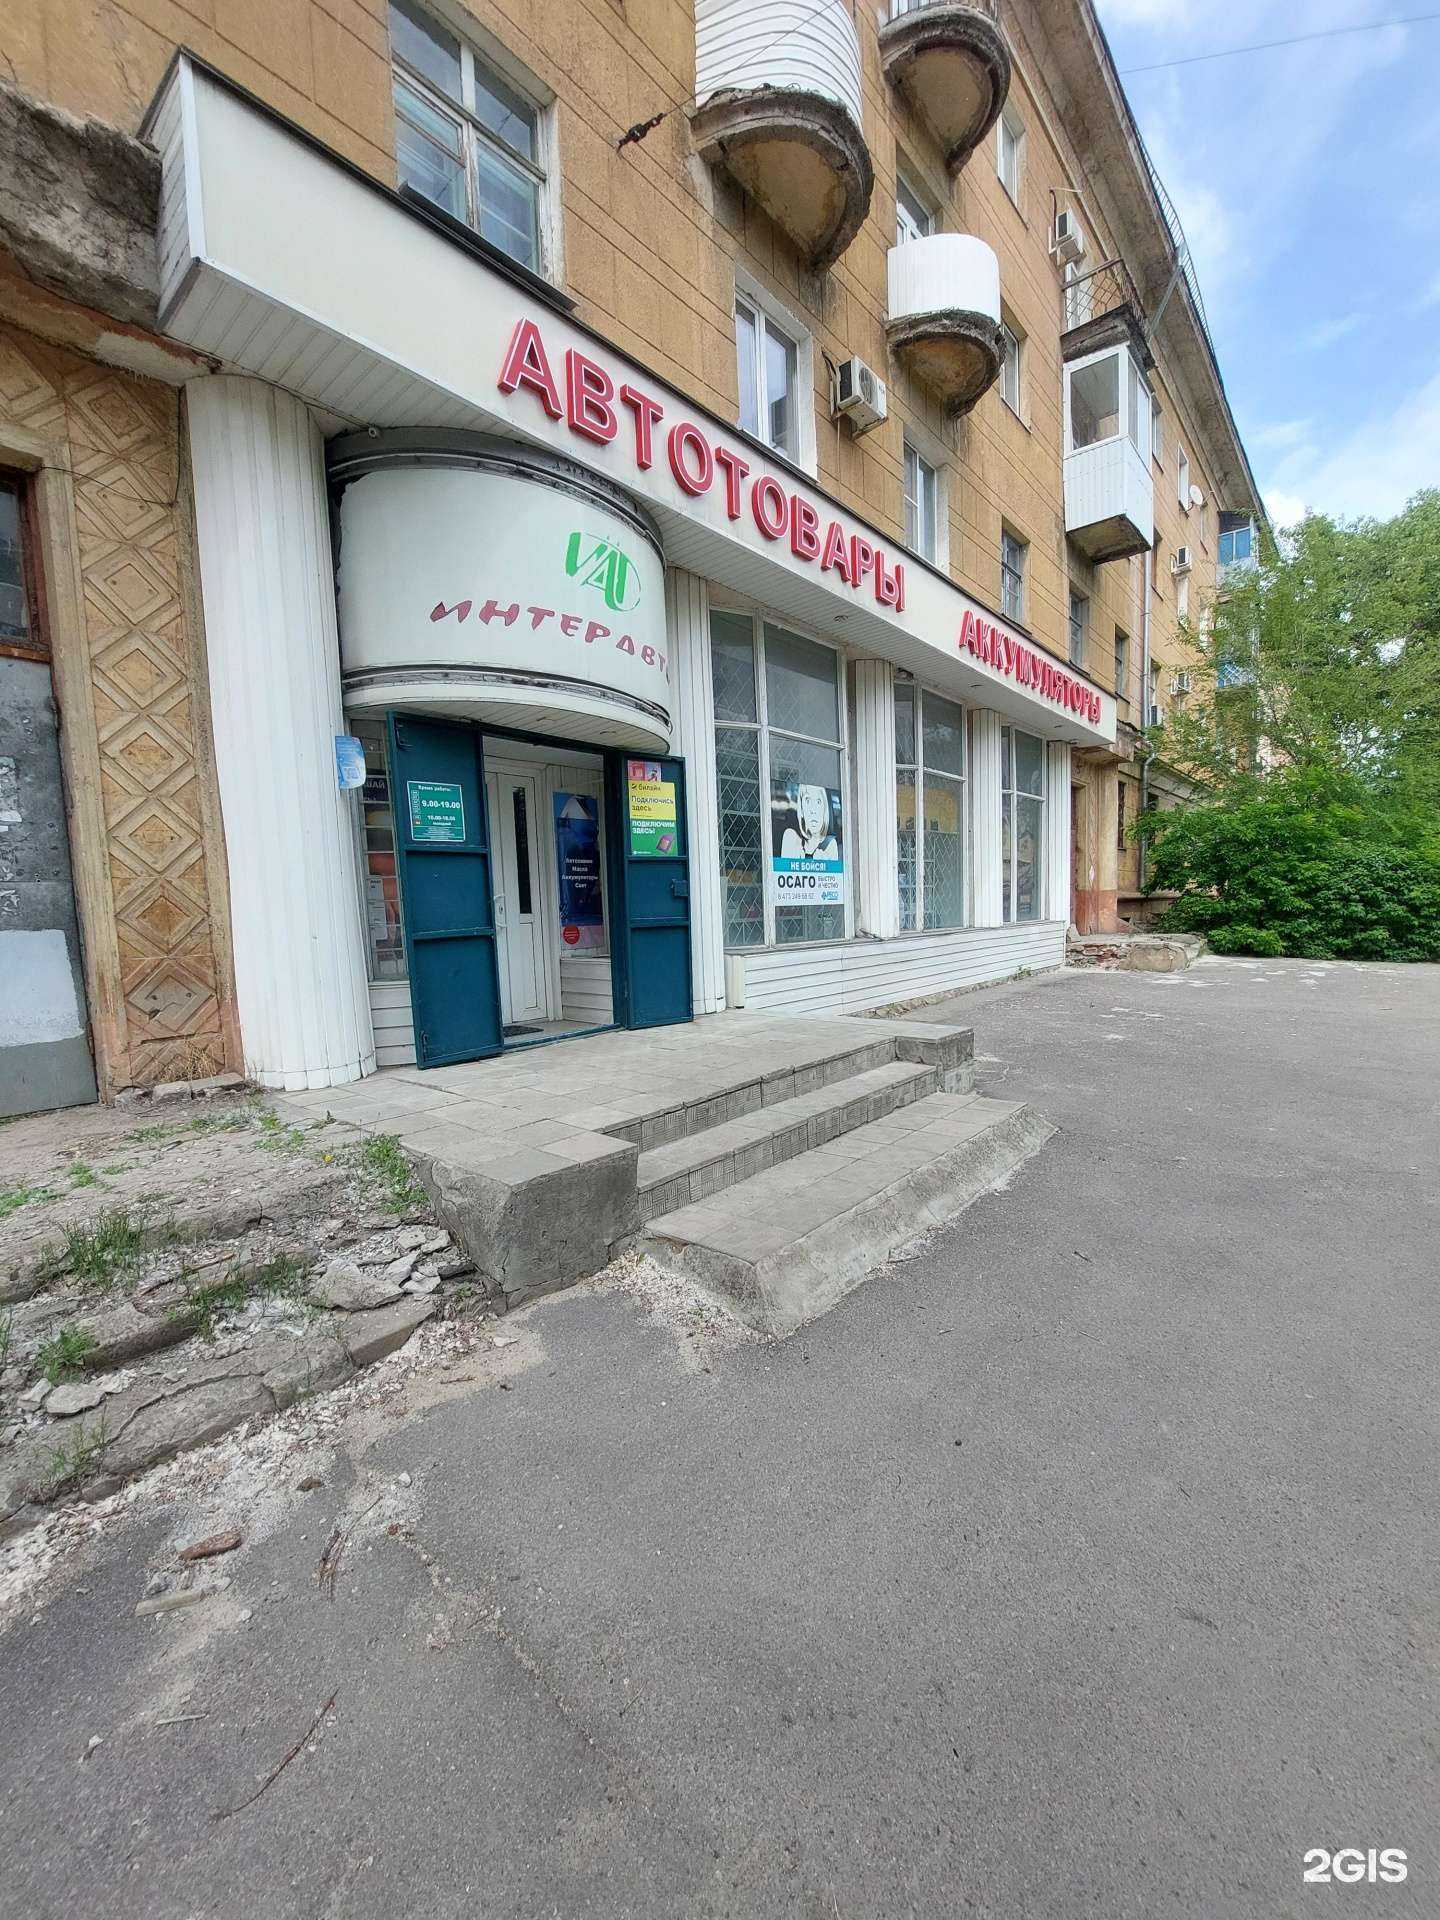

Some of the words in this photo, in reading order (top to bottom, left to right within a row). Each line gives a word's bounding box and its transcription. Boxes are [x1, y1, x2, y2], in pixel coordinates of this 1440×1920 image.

[497, 317, 905, 613] АВТОТОВАРЫ
[430, 600, 670, 685] ИНТЕРАВТ
[959, 610, 1101, 725] АККУМУЛЯТОРЫ
[778, 875, 816, 888] ОСАГО
[791, 862, 800, 871] НЕ
[801, 862, 826, 871] БОЙСЯ!
